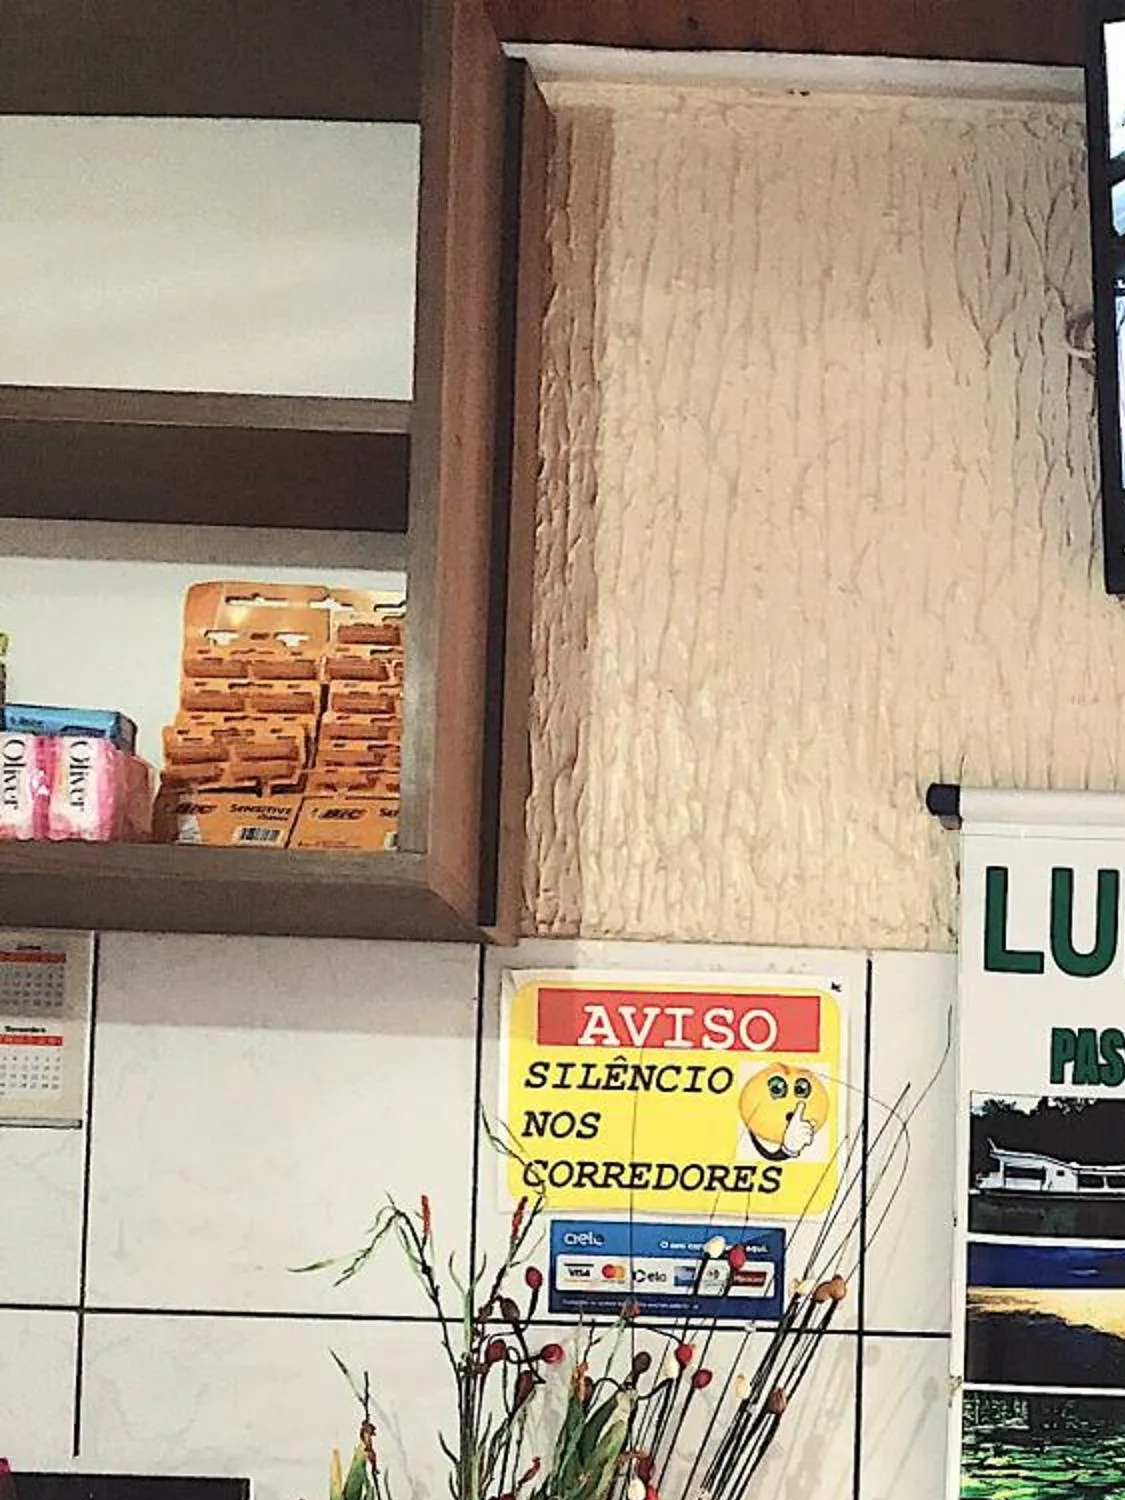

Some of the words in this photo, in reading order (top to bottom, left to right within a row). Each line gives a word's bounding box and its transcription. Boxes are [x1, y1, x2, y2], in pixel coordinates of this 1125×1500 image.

[577, 1004, 779, 1051] AVISO
[523, 1055, 734, 1094] SILÊNCIO
[521, 1110, 602, 1140] NOS
[522, 1159, 784, 1194] CORREDORES
